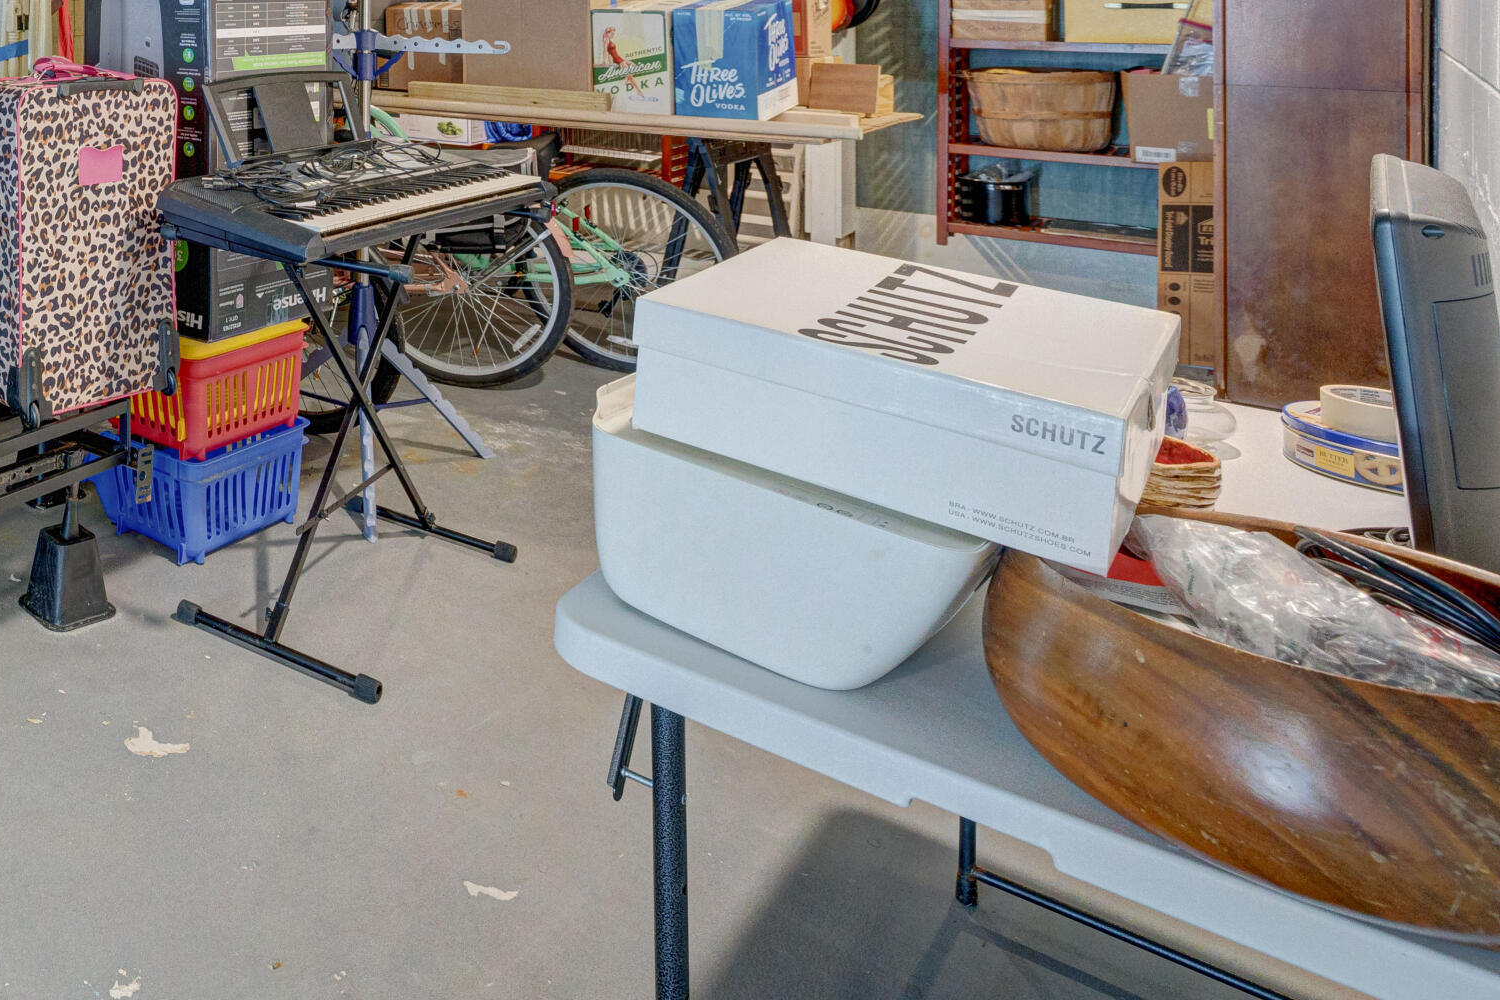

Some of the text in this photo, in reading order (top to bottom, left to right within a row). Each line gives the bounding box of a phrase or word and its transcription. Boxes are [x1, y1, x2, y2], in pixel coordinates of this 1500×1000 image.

[625, 46, 663, 58] AUTHENTIC
[598, 60, 661, 81] American
[715, 103, 746, 111] VODKA
[273, 287, 327, 311] Hense
[797, 263, 1018, 365] SCHUTZ
[1010, 414, 1106, 455] SCHUTZ
[948, 509, 966, 519] USA
[972, 516, 1091, 558] WWW.SCHUTZSHOES.COM
[949, 500, 967, 511] BRA
[972, 507, 1075, 544] WWW.SCHUTZ.COM.BR
